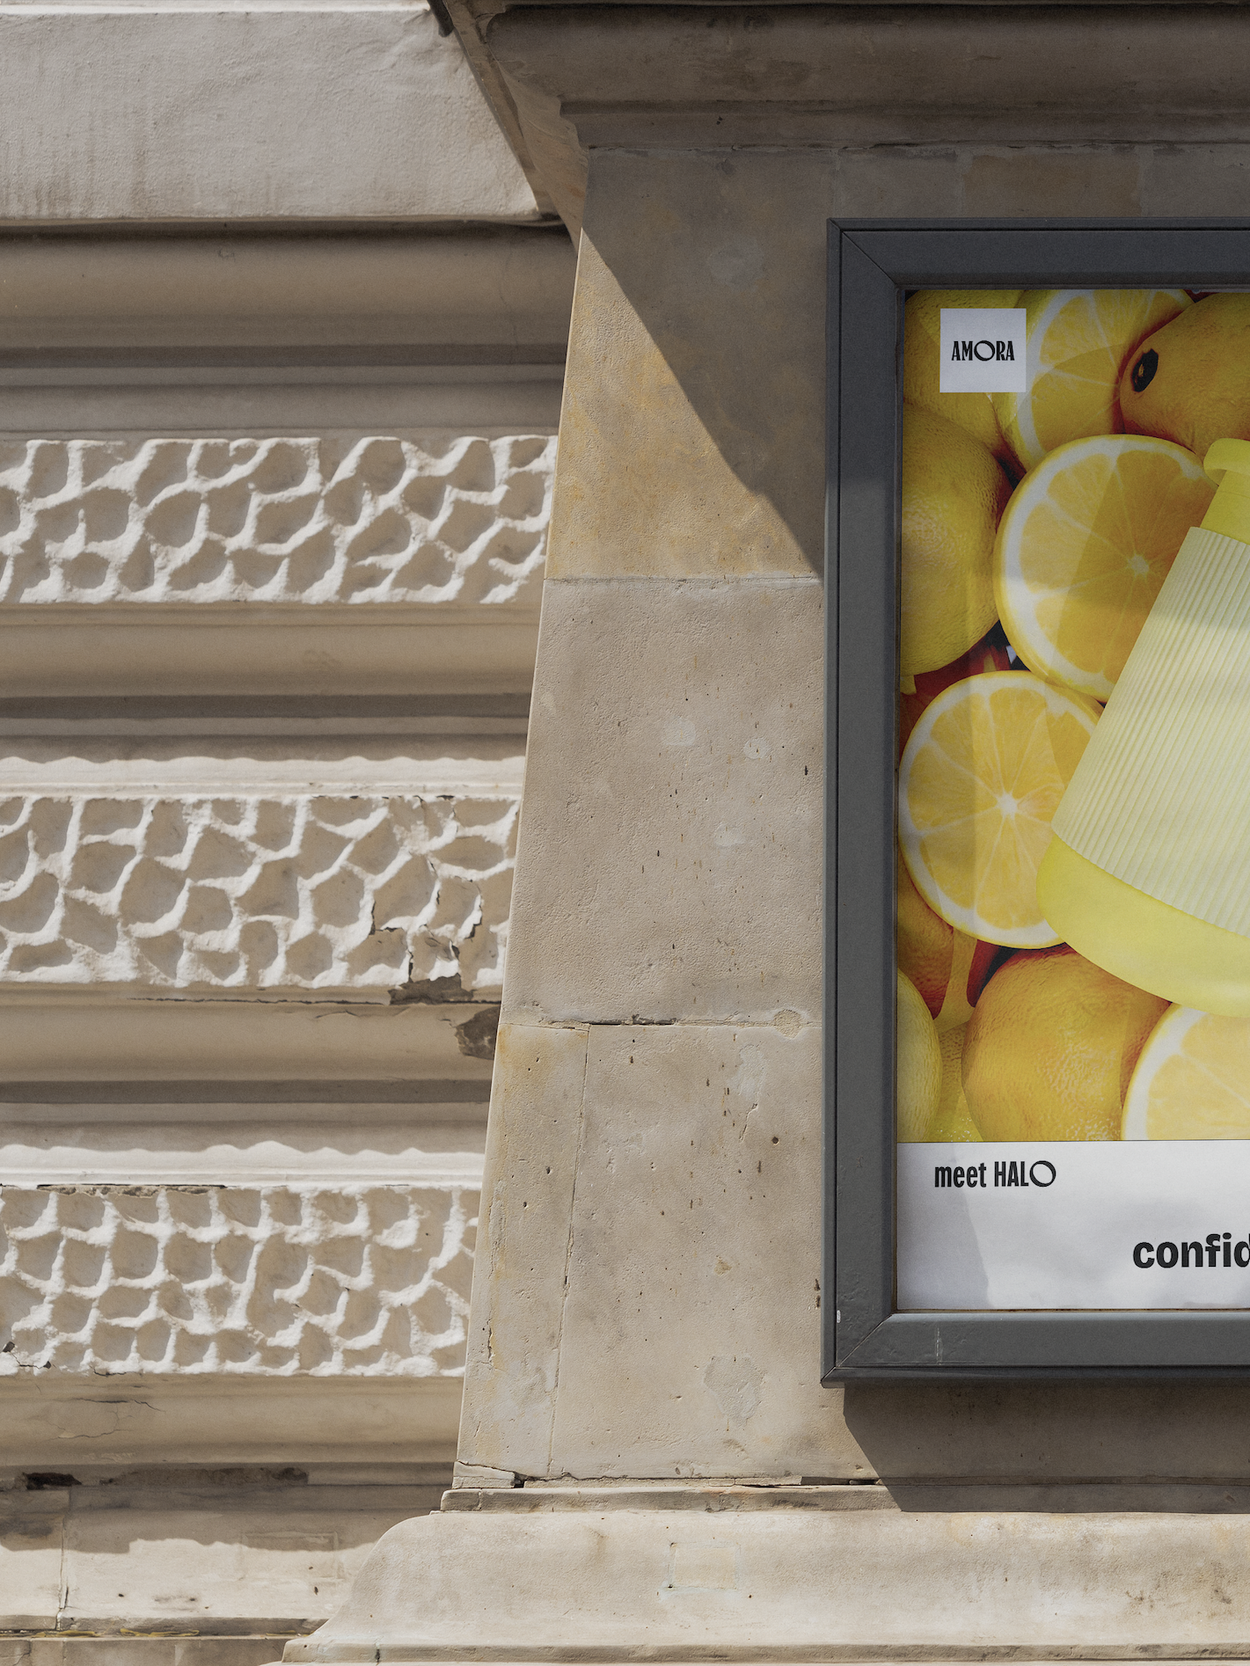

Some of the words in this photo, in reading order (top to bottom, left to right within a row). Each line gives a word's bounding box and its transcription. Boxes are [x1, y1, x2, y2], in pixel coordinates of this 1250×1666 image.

[951, 340, 1015, 361] AMORA
[934, 1162, 987, 1188] meet
[994, 1160, 1057, 1188] HALO
